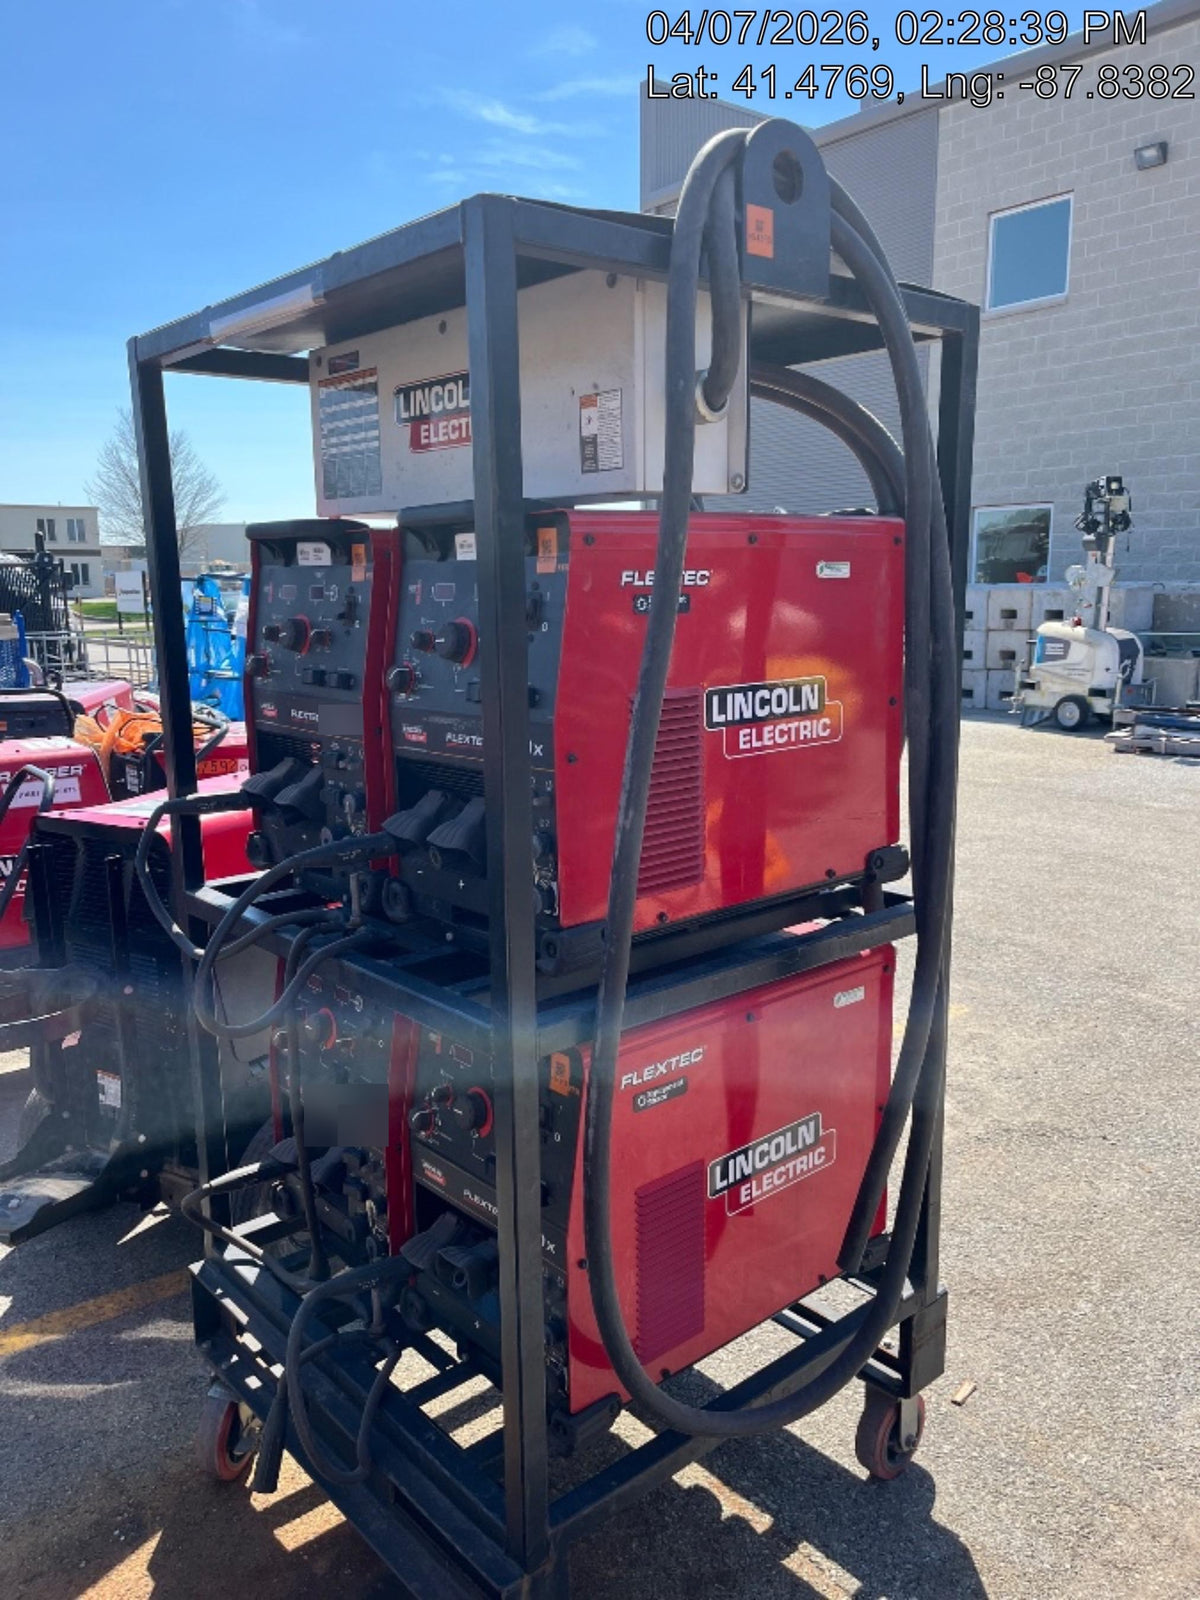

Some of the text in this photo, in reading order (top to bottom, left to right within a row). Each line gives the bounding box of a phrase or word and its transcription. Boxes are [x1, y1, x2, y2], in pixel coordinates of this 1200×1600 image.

[400, 380, 470, 418] LINCOL
[621, 570, 710, 586] FLEEC
[712, 684, 819, 722] LINCOLN
[446, 732, 484, 746] FLEXTE
[739, 717, 831, 750] ELECTRIC
[620, 1047, 704, 1091] FLEXTEC
[715, 1120, 816, 1190] LINCOLN
[740, 1146, 826, 1204] ELECTRIC
